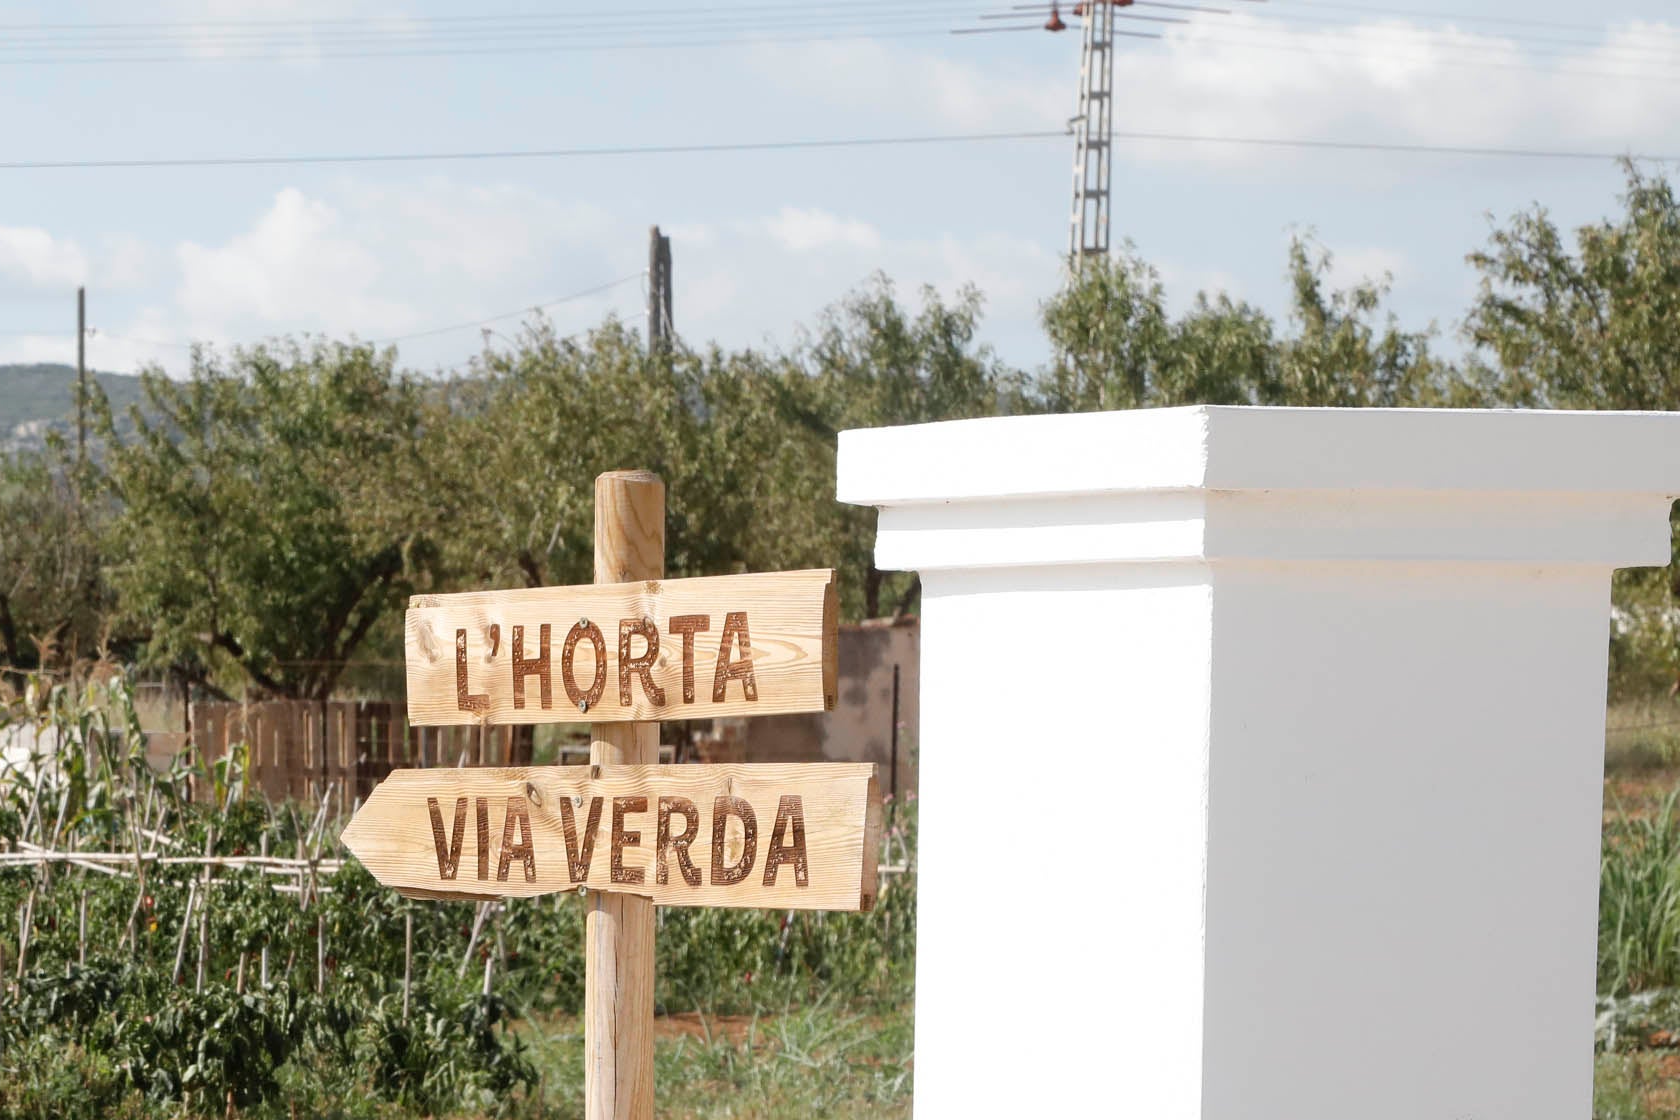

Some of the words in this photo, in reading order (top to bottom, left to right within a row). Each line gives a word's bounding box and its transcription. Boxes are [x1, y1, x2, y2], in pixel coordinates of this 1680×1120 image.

[456, 611, 759, 712] L'HORTA
[427, 796, 537, 883] VIA
[559, 795, 809, 888] VERDA
